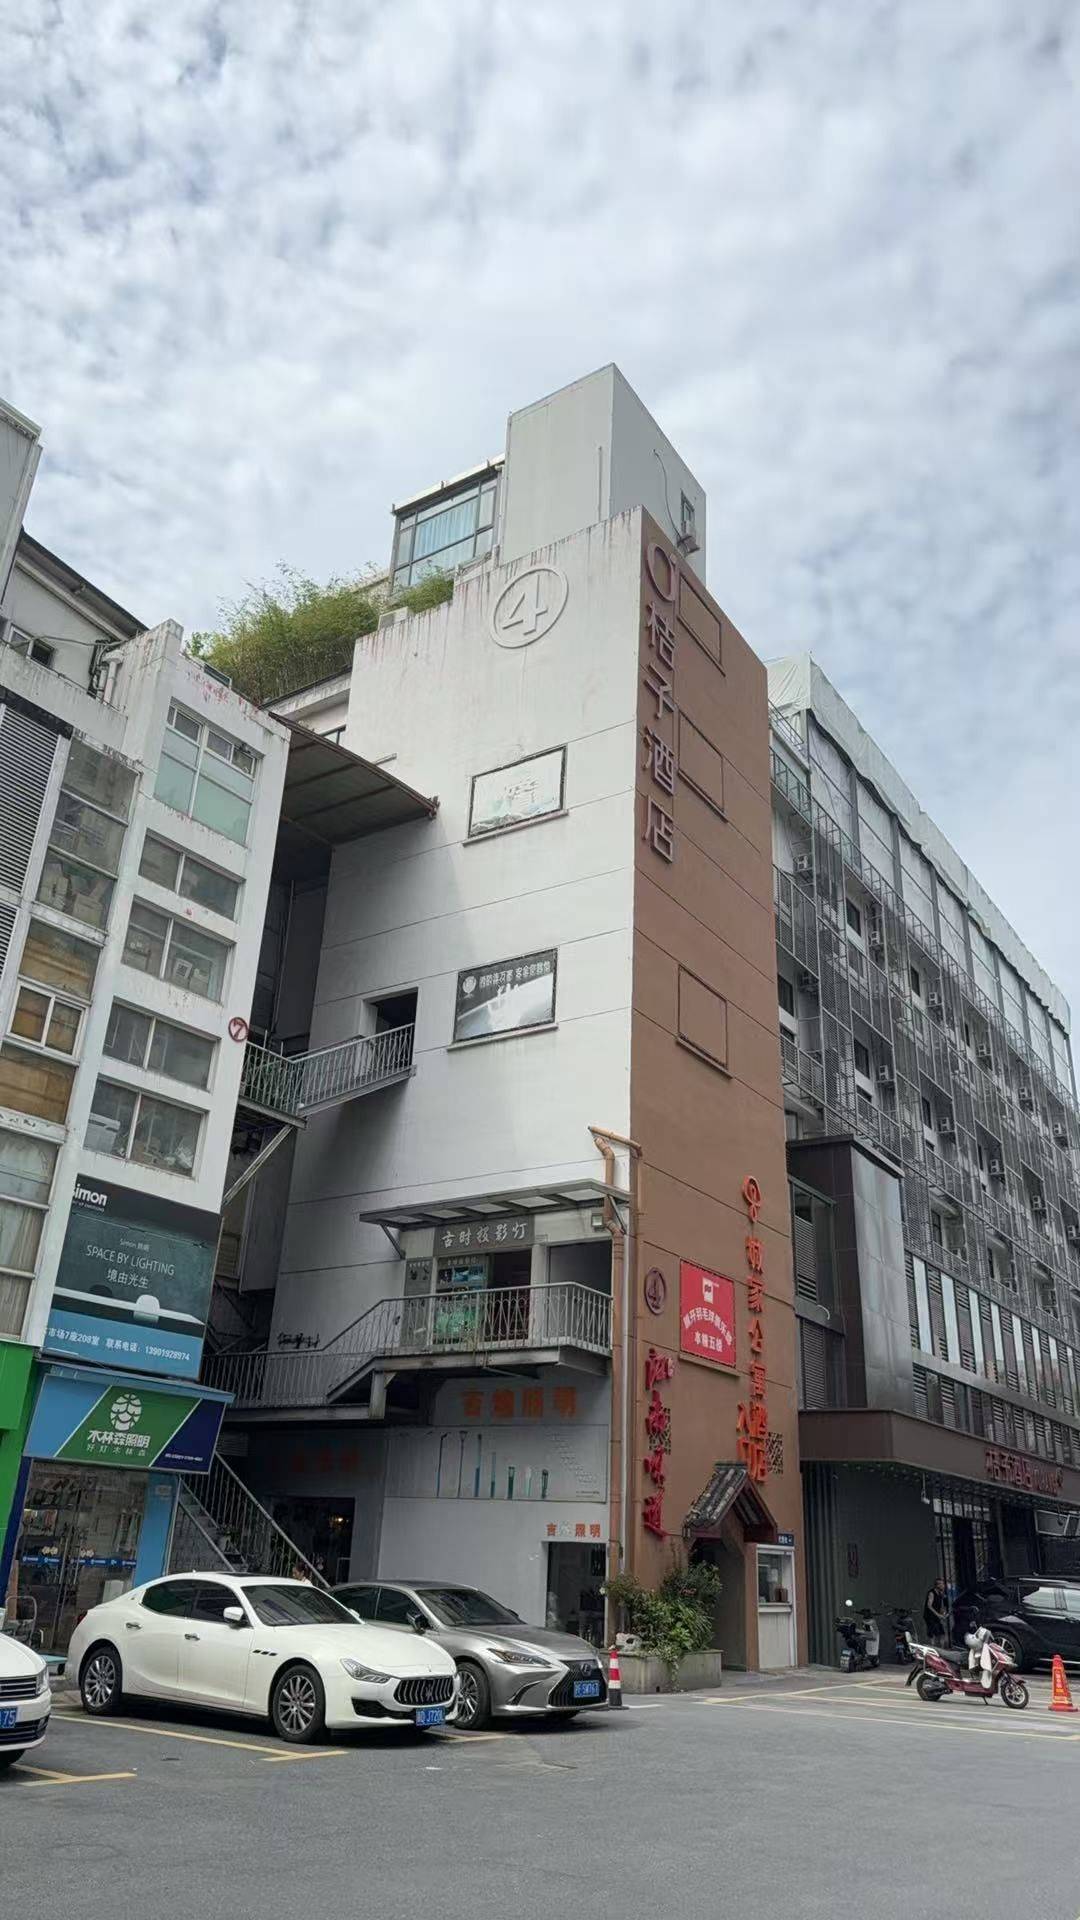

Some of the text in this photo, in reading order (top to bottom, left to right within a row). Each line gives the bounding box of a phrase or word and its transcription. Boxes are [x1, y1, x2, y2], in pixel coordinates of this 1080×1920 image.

[641, 601, 676, 864] 桔子酒店
[73, 1184, 108, 1207] imon
[86, 1245, 175, 1276] SPACE BY LIGHTING
[106, 1268, 149, 1289] 境由光生
[87, 1430, 151, 1448] 木林森照明
